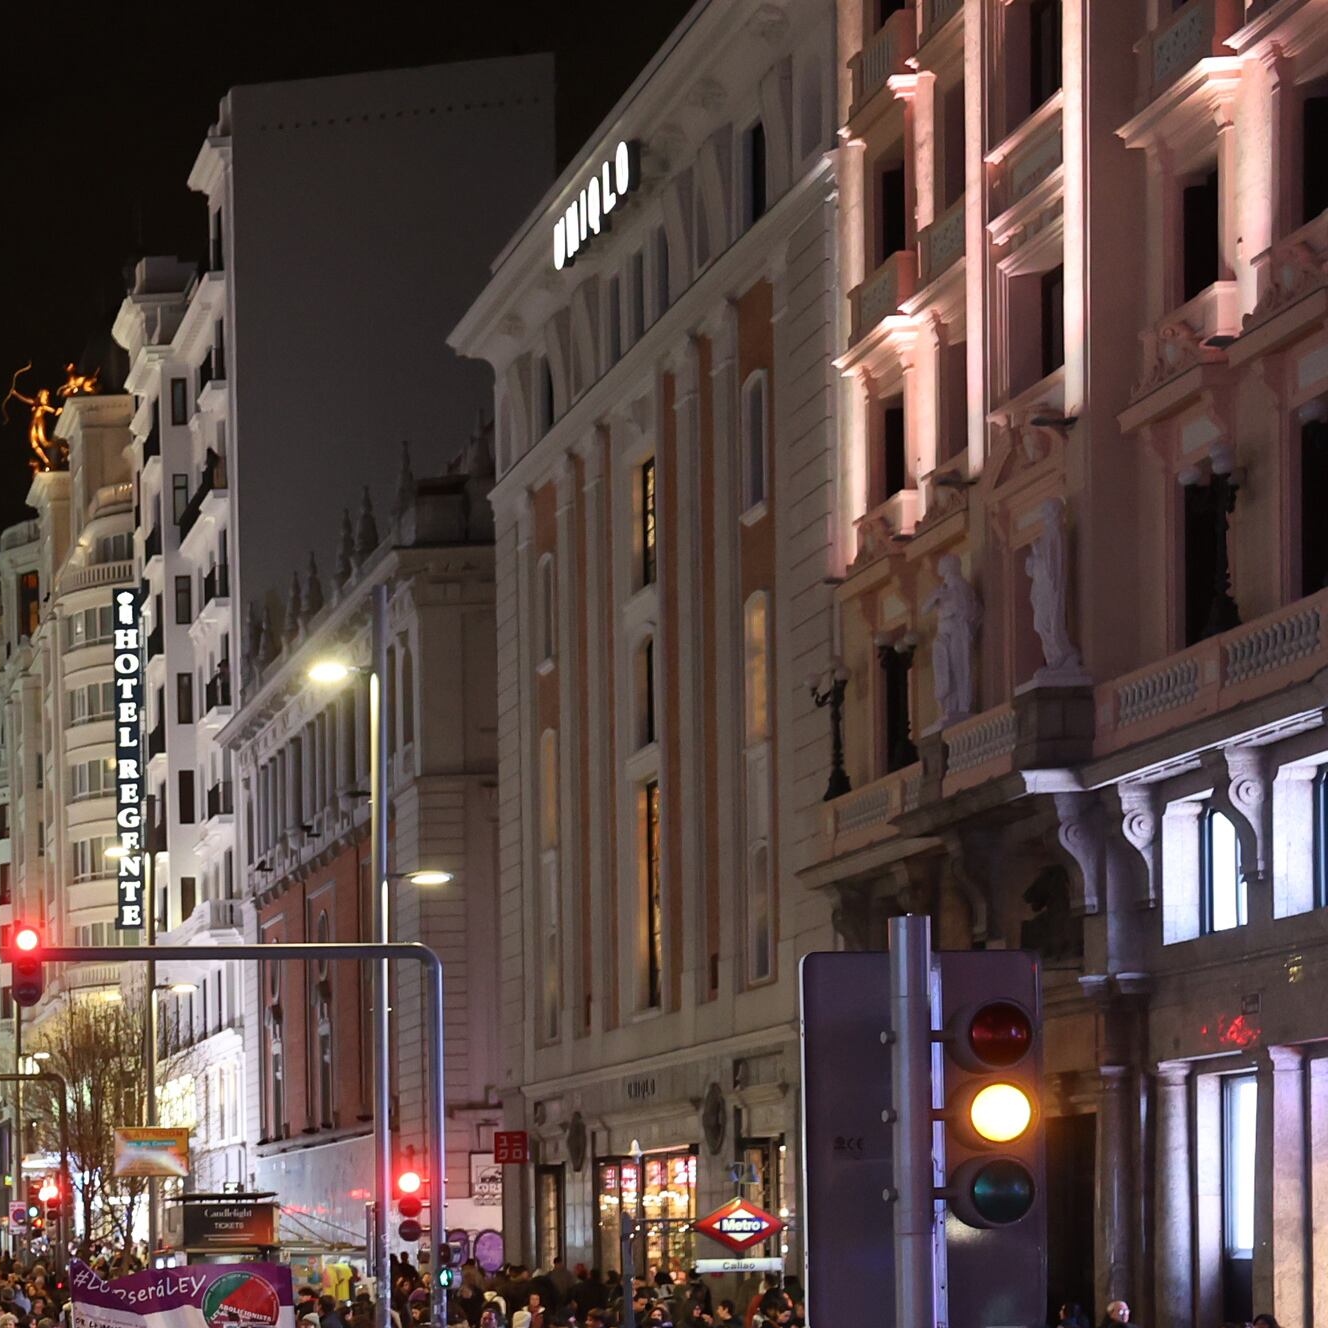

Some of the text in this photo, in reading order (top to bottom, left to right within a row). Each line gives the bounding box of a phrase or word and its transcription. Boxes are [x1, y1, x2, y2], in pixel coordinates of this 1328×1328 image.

[553, 141, 629, 270] UNIQLO
[114, 628, 142, 927] HOTEL REGENTE
[204, 1208, 252, 1218] Candlelight
[722, 1218, 762, 1232] Metro
[722, 1260, 756, 1270] Callao
